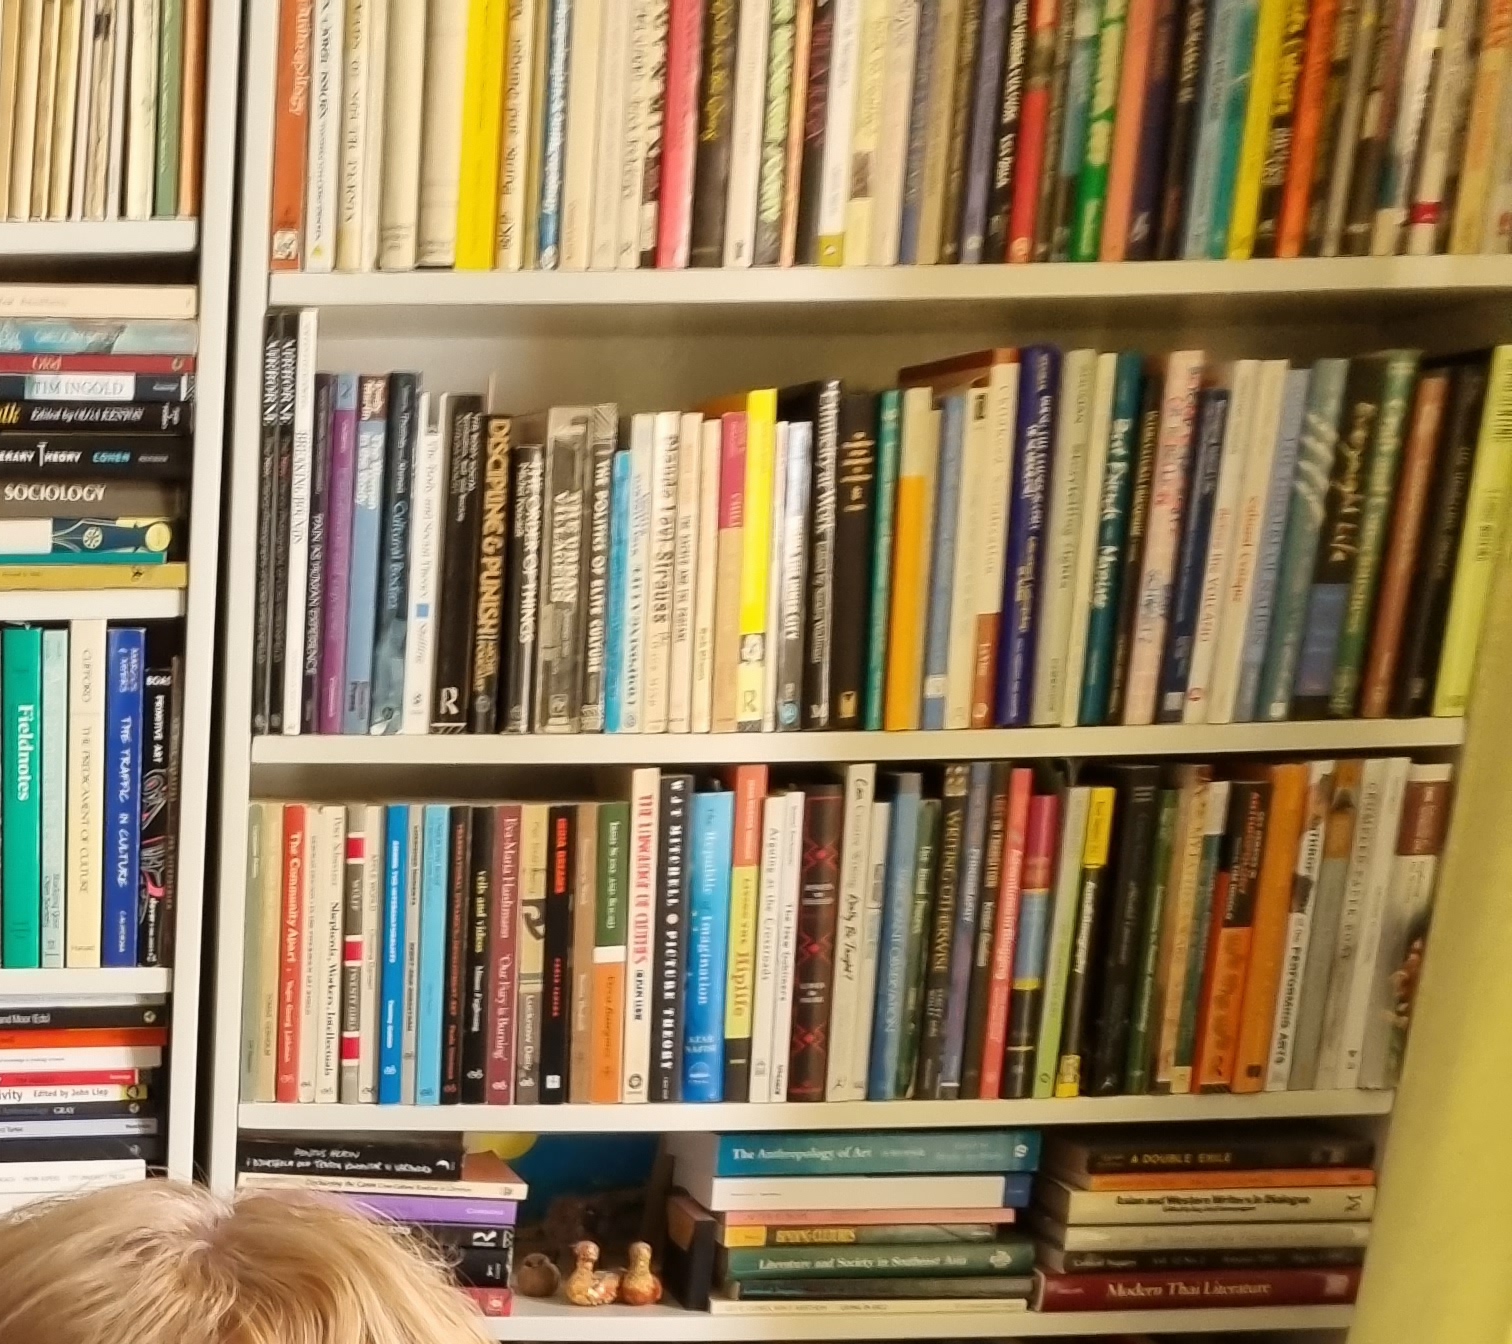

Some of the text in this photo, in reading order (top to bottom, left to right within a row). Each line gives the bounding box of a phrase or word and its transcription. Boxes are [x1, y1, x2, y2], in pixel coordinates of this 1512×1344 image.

[34, 382, 123, 395] TIM INGOLD
[5, 483, 106, 501] SOCIOLOGY
[482, 419, 510, 535] DISCIPLINE
[477, 555, 501, 635] PUNISH
[16, 704, 33, 801] Fieldnotes
[659, 931, 678, 1069] PICTURE THEORY
[731, 951, 749, 1017] Hiplife
[732, 1147, 872, 1164] The Anthropology of Art
[1107, 1278, 1271, 1296] Modern Thai Literature
